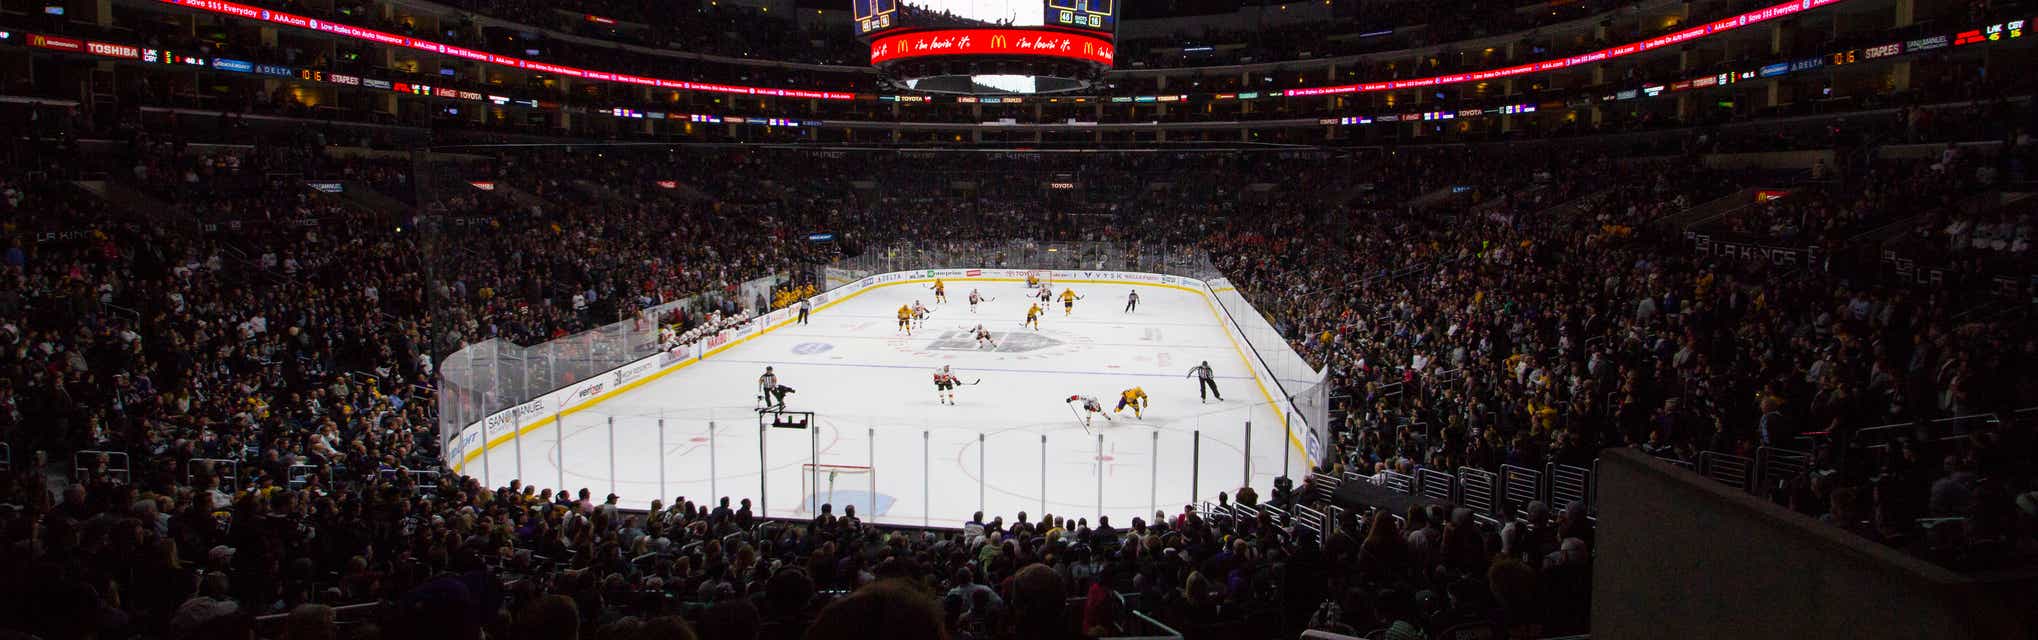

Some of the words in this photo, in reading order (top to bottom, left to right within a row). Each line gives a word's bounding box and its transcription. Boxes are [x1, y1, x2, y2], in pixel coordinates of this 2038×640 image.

[224, 5, 257, 17] Everyday
[274, 14, 306, 26] AAA.com
[88, 43, 139, 58] TOSHIBA
[1865, 43, 1900, 59] STAPLES
[264, 66, 292, 76] DELTA
[331, 74, 359, 86] STAPLES
[460, 91, 483, 100] TOYOTA
[1459, 109, 1482, 117] TOYOTA
[488, 414, 505, 430] SAN
